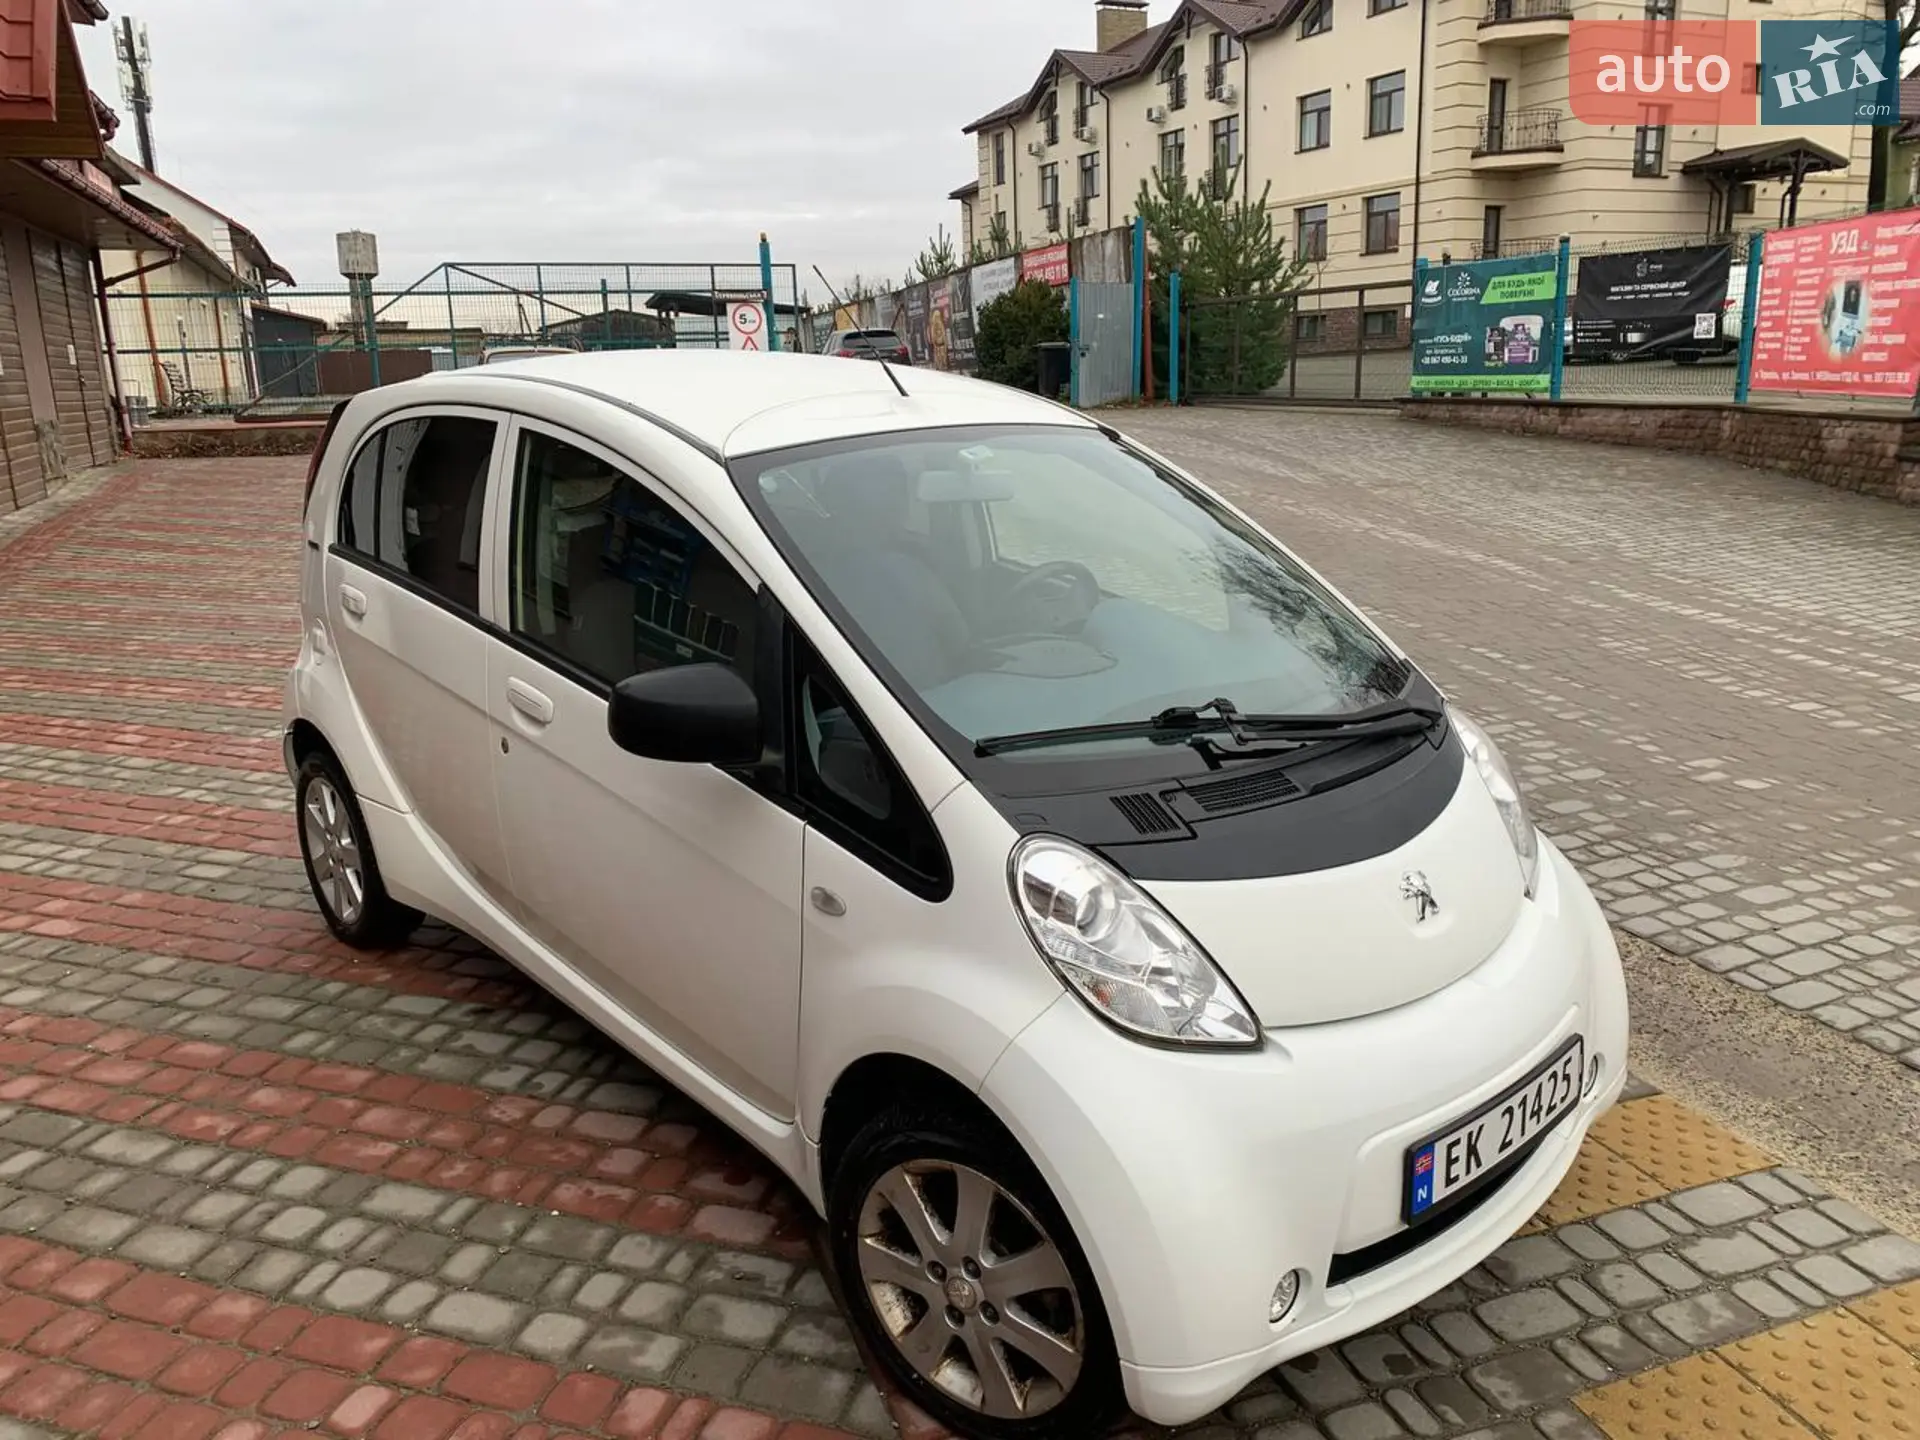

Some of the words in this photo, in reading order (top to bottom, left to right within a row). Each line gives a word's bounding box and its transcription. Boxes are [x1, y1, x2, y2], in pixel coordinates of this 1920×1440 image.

[1829, 228, 1860, 255] УЗД
[739, 313, 748, 325] 5
[1444, 1123, 1486, 1189] EK
[1498, 1055, 1573, 1155] 21425
[1417, 1185, 1428, 1202] N
